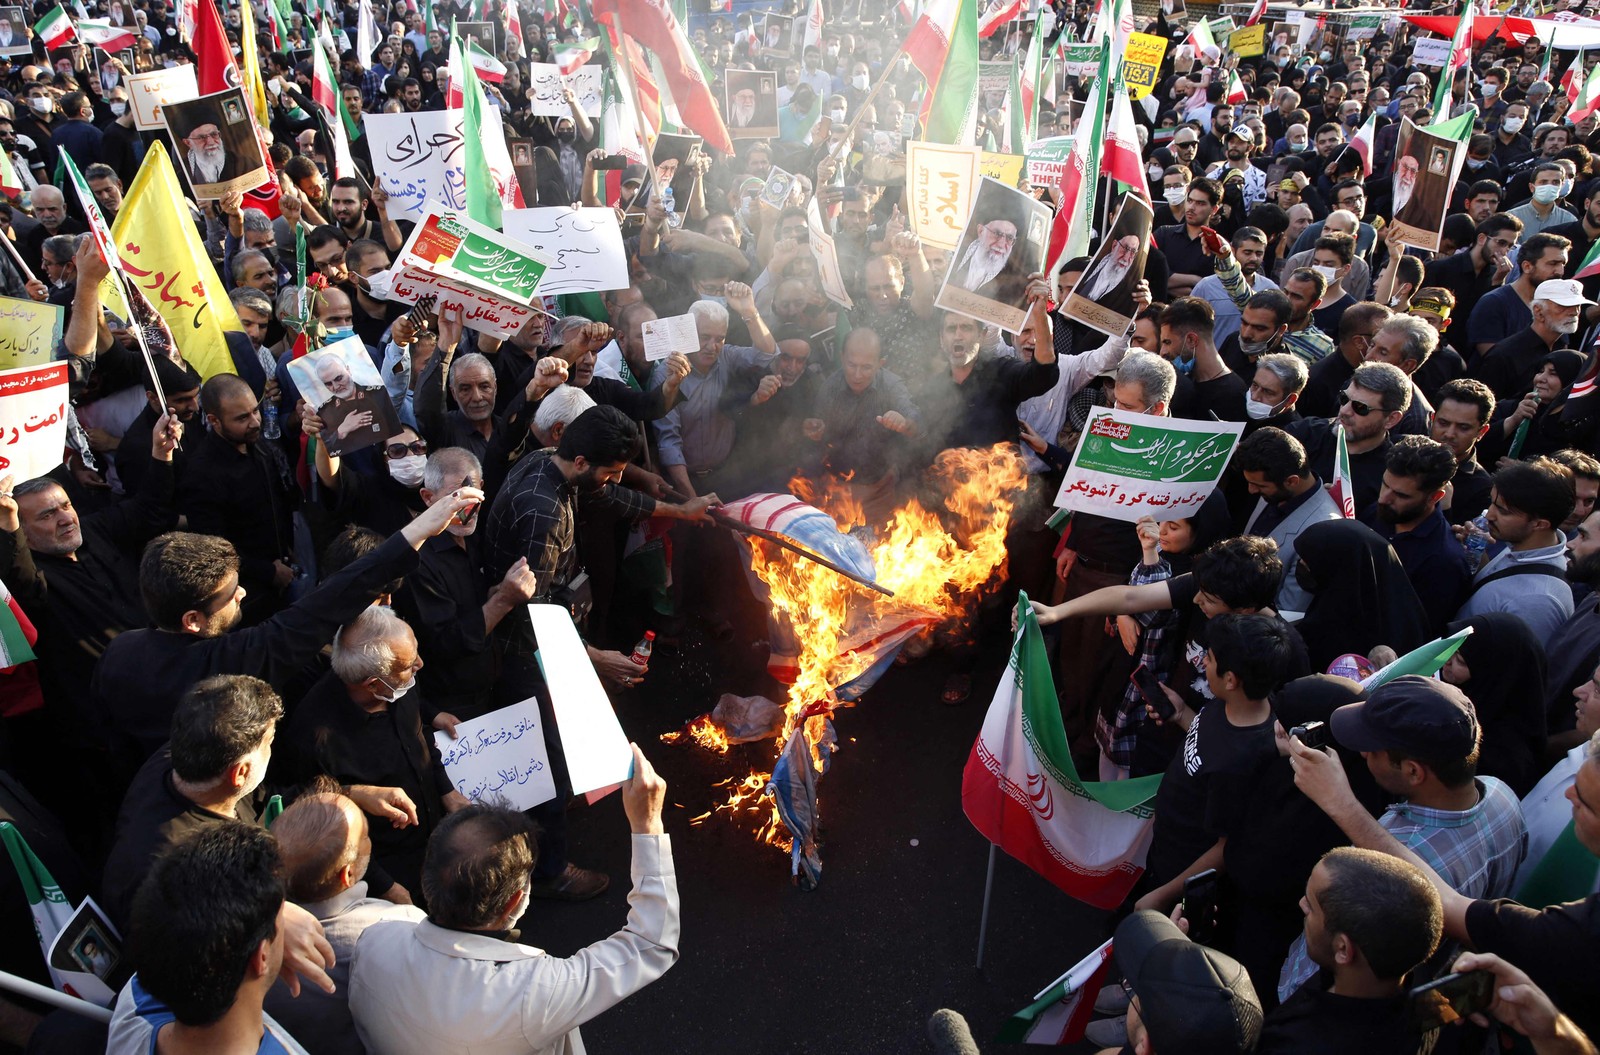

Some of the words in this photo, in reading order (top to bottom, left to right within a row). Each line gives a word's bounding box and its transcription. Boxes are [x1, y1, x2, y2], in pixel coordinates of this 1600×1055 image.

[1123, 66, 1150, 84] USA
[1032, 174, 1051, 185] THE
[936, 171, 963, 231] اسلام
[403, 271, 436, 285] است
[436, 282, 475, 299] ملت
[478, 293, 500, 309] یک
[466, 306, 501, 325] مقابل
[500, 304, 528, 317] قیام
[501, 320, 520, 330] در
[24, 402, 65, 434] امت
[1115, 492, 1124, 505] و
[1147, 491, 1171, 506] فتنه
[1167, 495, 1182, 509] بر
[1182, 491, 1206, 505] مرگ
[512, 717, 535, 740] منافق
[489, 765, 519, 792] انقلاب
[517, 758, 543, 785] دشمن
